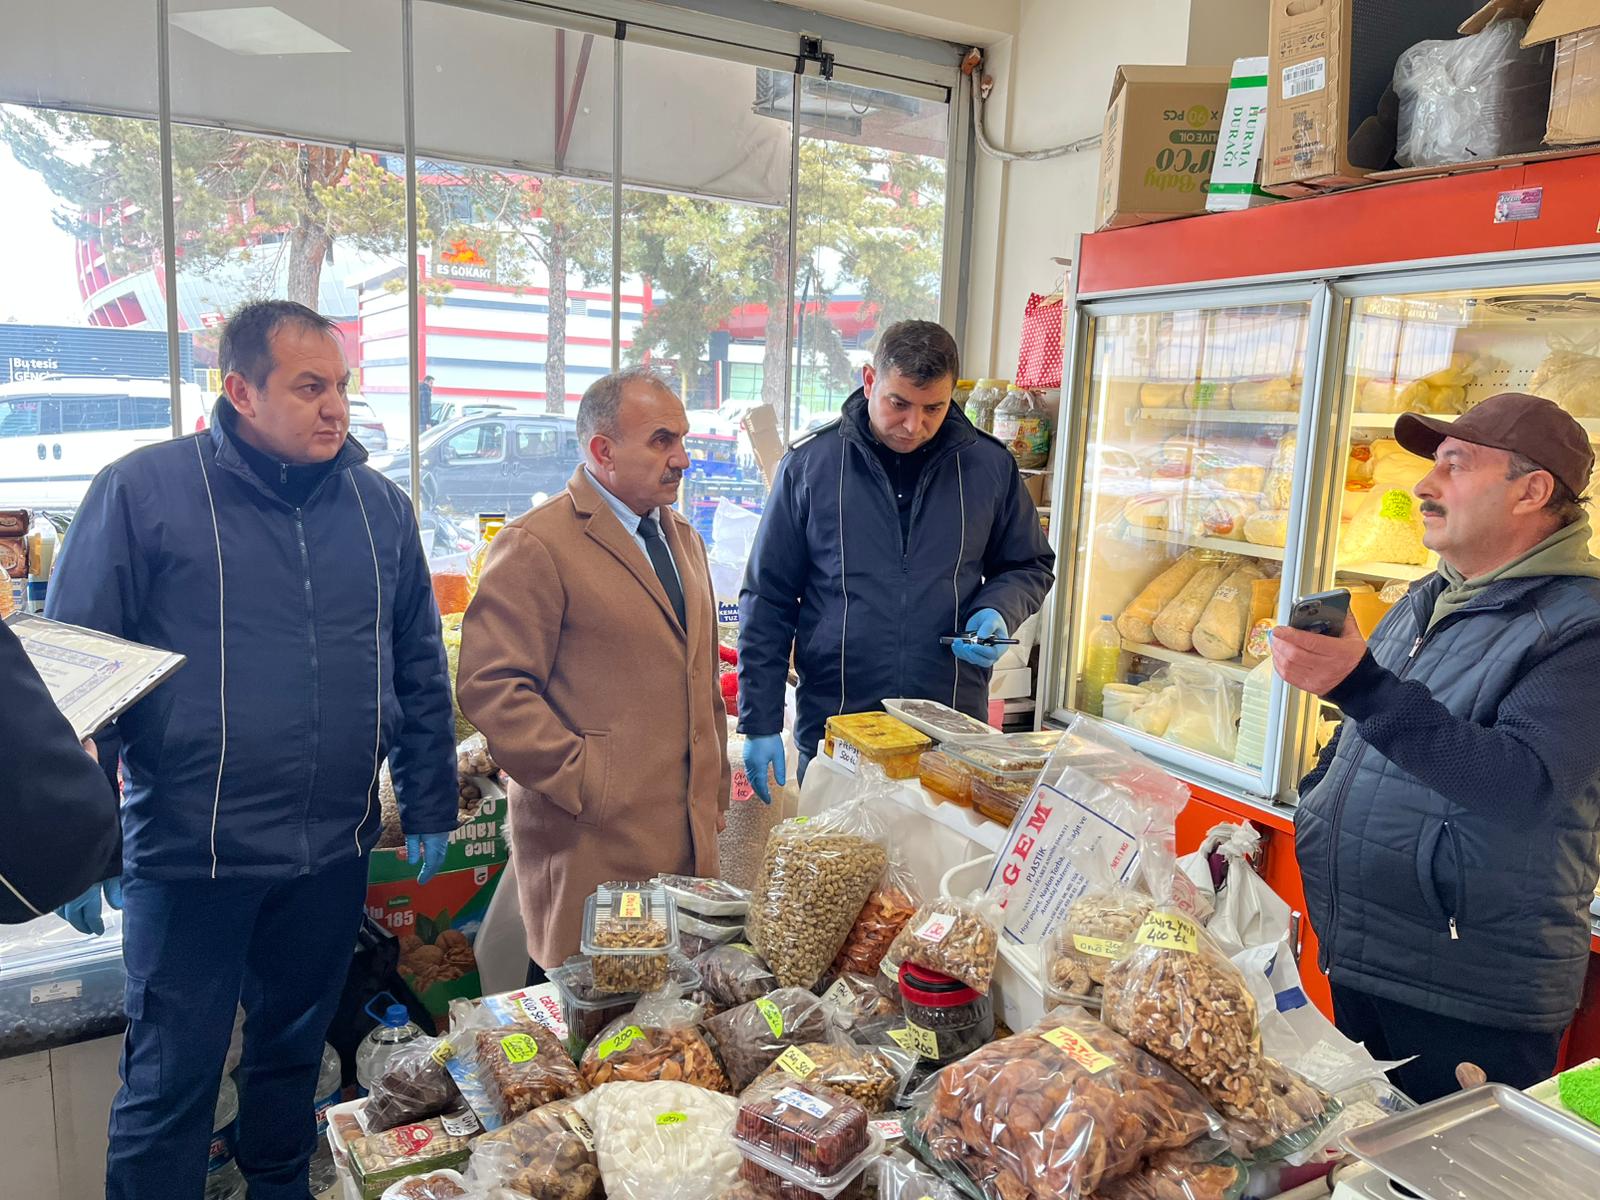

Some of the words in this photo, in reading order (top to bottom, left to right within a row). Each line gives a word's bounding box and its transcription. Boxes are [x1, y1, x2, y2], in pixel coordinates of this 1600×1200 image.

[1163, 110, 1185, 121] PCS
[1179, 132, 1195, 143] OIL
[1223, 107, 1243, 168] DURAĞI
[1238, 106, 1260, 168] HURMA
[1144, 166, 1196, 193] Baby
[436, 264, 449, 275] ES
[450, 264, 492, 279] GOKART
[30, 358, 58, 369] tesis
[464, 840, 496, 858] ince
[1038, 873, 1055, 900] Naylon
[1078, 814, 1087, 825] ve
[1025, 845, 1047, 883] PLASTİK
[385, 909, 414, 928] 185
[1147, 929, 1169, 943] 400
